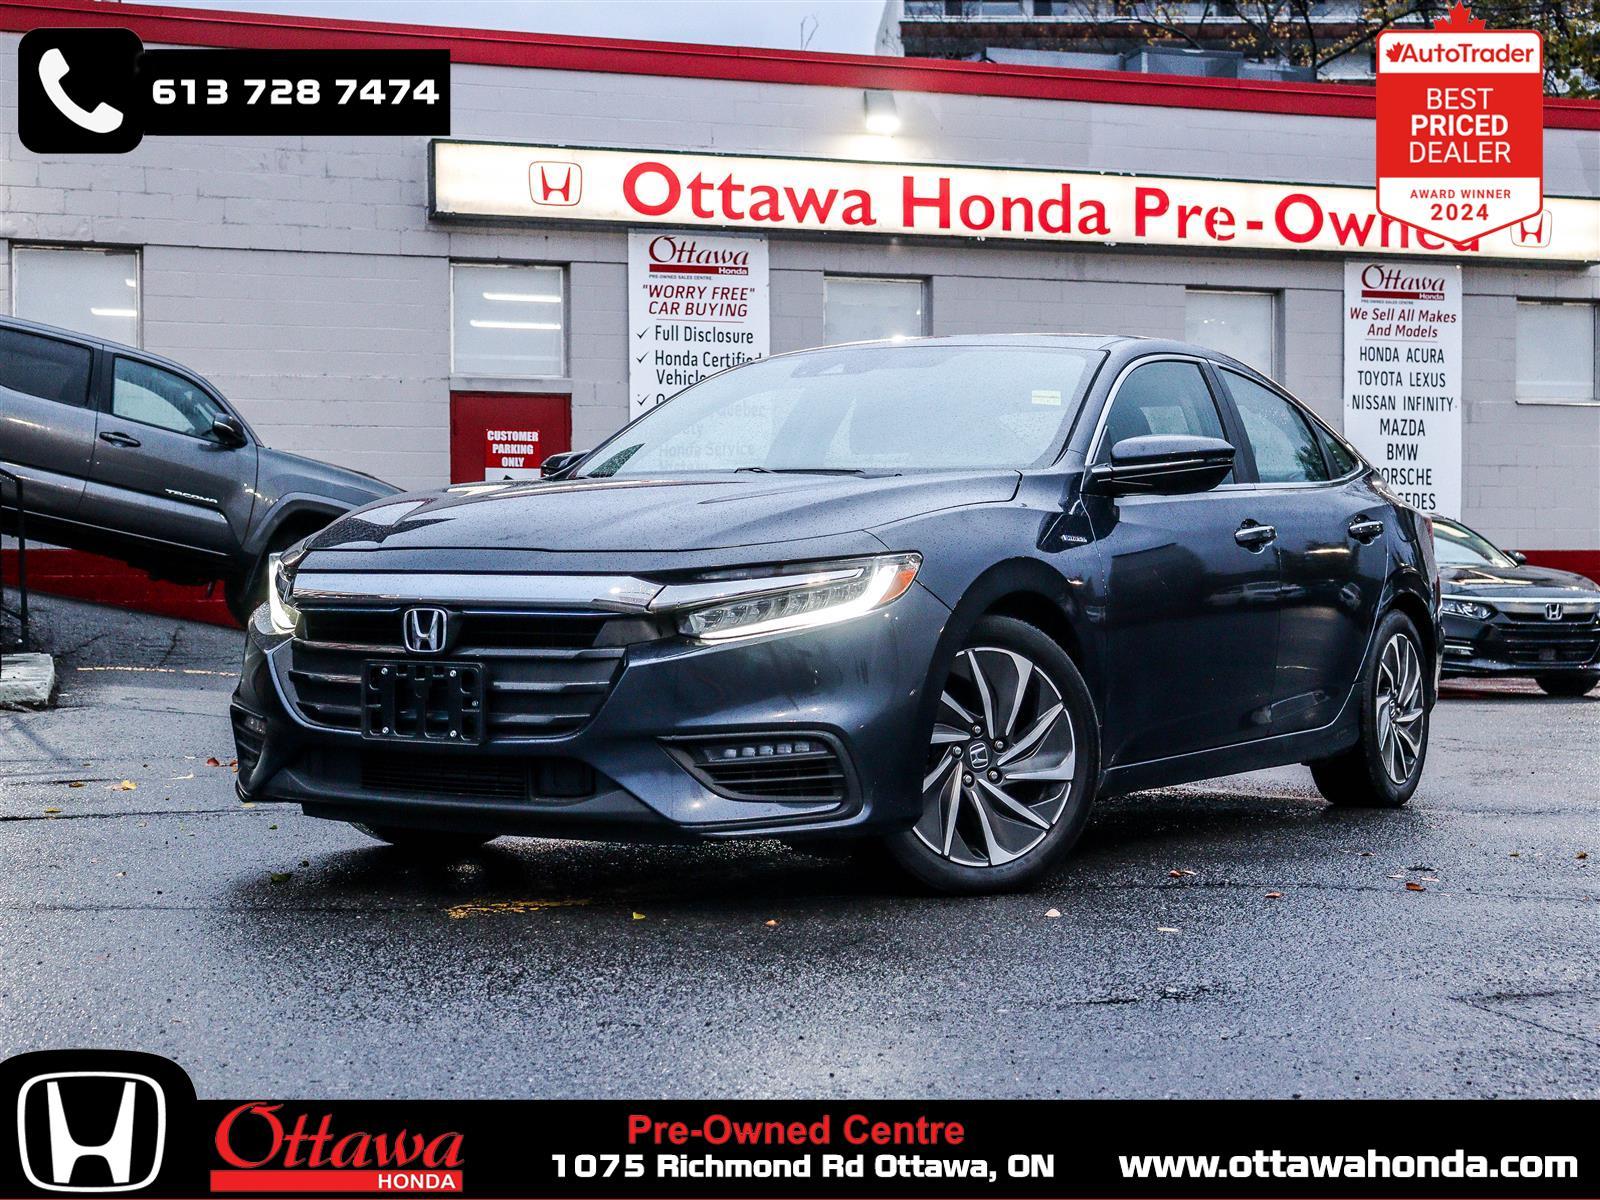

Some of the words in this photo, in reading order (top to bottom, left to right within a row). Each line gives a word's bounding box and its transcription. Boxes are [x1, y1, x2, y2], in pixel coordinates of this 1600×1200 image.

[623, 161, 877, 226] Ottawa
[902, 175, 1111, 235] Honda
[1135, 186, 1480, 252] Pre-Own
[649, 235, 749, 265] Ottawa
[718, 266, 748, 275] Honda
[1361, 263, 1446, 292] Ottawa
[643, 284, 708, 300] "WORRY
[712, 286, 756, 301] FREE"
[648, 301, 681, 315] CAR
[684, 302, 748, 318] BUYING
[1350, 307, 1368, 320] We
[1372, 307, 1395, 321] Sell
[1397, 308, 1415, 322] All
[1418, 309, 1457, 324] Makes
[655, 324, 679, 341] Full
[684, 325, 754, 344] Disclosure
[1367, 323, 1392, 337] And
[1395, 324, 1438, 338] Models
[655, 349, 698, 367] Honda
[1359, 346, 1400, 362] HONDA
[1406, 347, 1445, 364] ACURA
[1357, 370, 1403, 387] TOYOTA
[1409, 372, 1446, 388] LEXUS
[1352, 394, 1396, 411] NISSAN
[1403, 395, 1454, 412] INFINITY
[486, 430, 539, 442] CUSTOMER
[1380, 418, 1426, 437] MAZDA
[492, 443, 534, 455] PARKING
[1386, 443, 1419, 461] BMW
[501, 456, 525, 468] ONLY
[1377, 467, 1433, 486] ORSCHE
[165, 488, 218, 504] TACOMA
